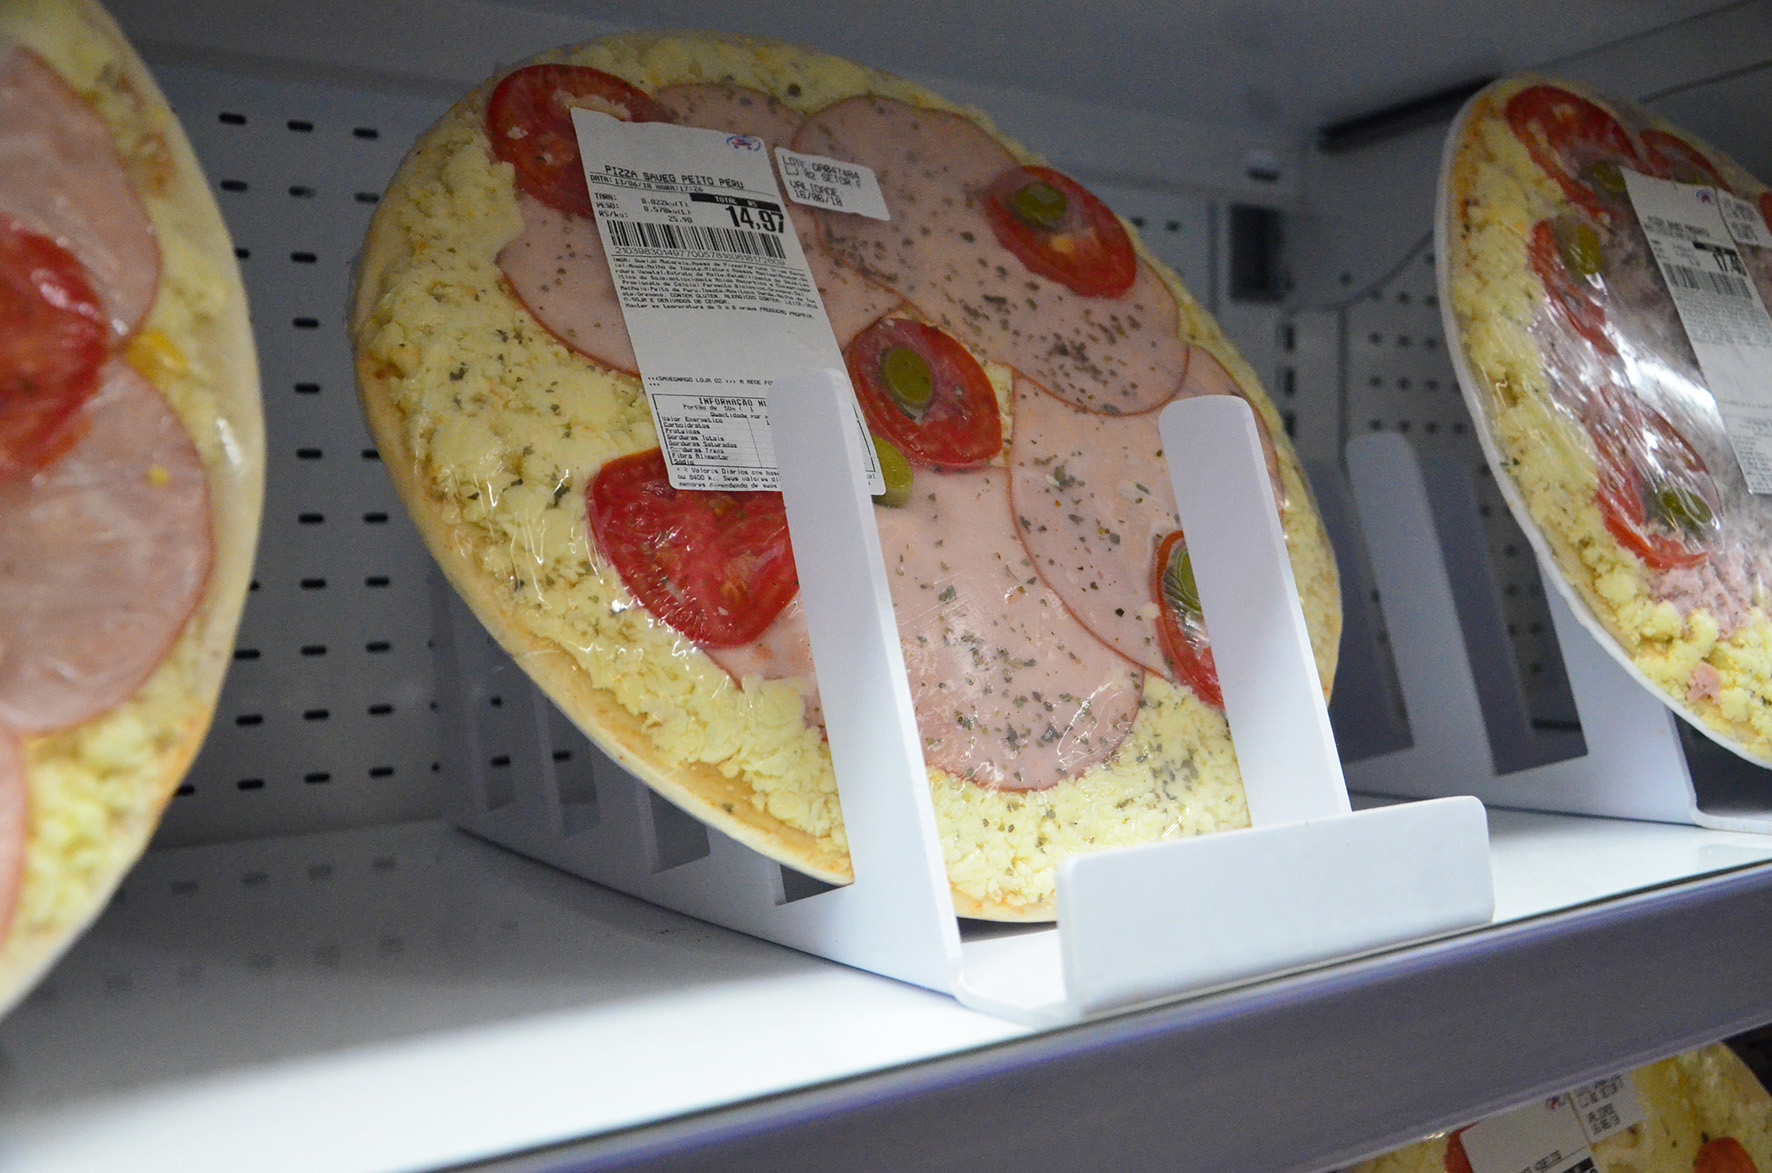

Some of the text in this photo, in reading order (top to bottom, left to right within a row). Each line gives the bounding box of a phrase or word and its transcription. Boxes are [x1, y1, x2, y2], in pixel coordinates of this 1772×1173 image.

[605, 165, 744, 190] PIZZA SAVEG PEITO PERU
[615, 178, 652, 189] 13/06/18
[789, 180, 838, 196] VALIDADE
[594, 192, 617, 200] TARA:
[714, 196, 738, 204] TOTAL
[725, 206, 784, 234] 14,97
[698, 397, 753, 406] INFORMAÇÃO
